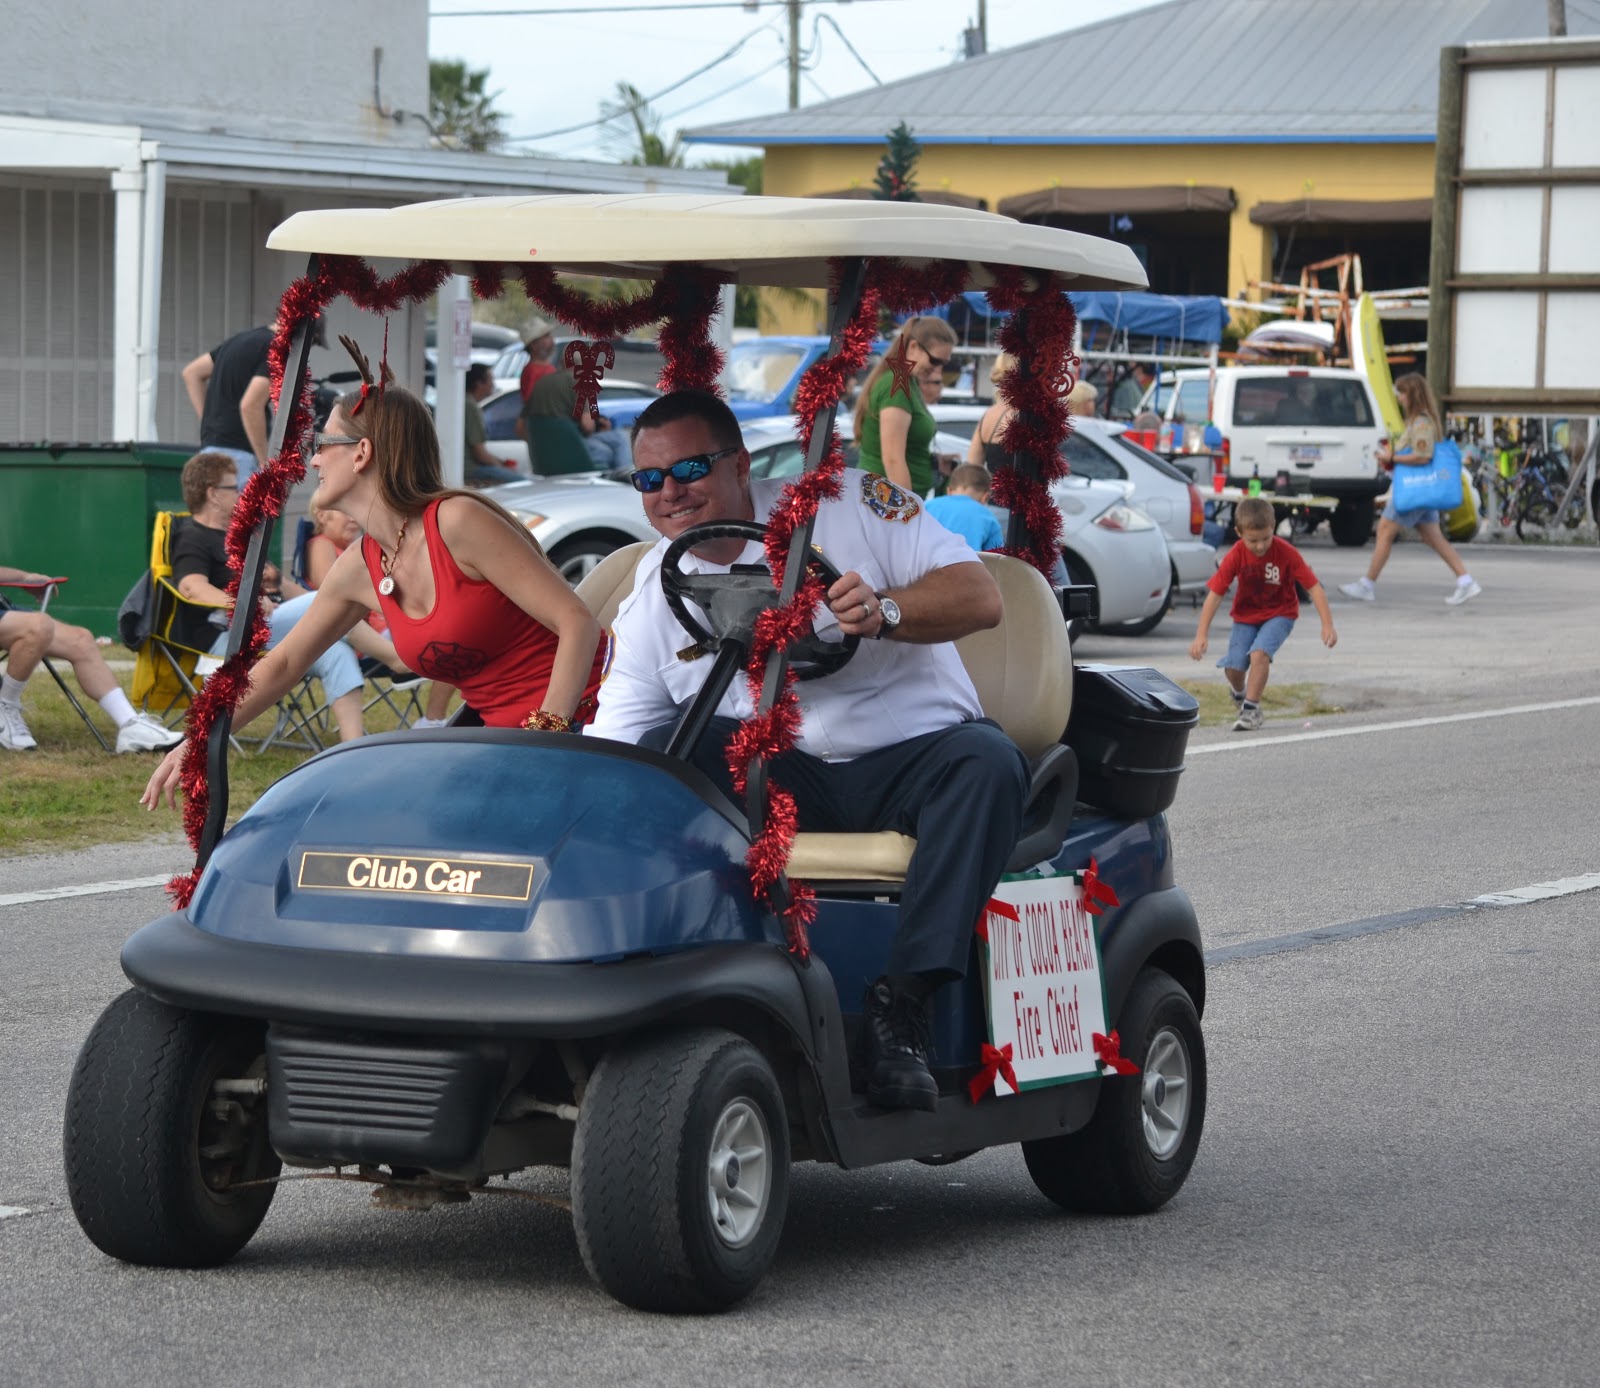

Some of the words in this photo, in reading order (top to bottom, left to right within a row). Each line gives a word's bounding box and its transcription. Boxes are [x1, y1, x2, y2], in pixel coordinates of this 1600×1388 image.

[347, 857, 417, 890] Club
[424, 861, 481, 893] Car
[1026, 901, 1062, 976] COCOA
[1059, 899, 1094, 972] BEACH
[1013, 990, 1044, 1060] Fire
[1047, 984, 1083, 1056] Chief
